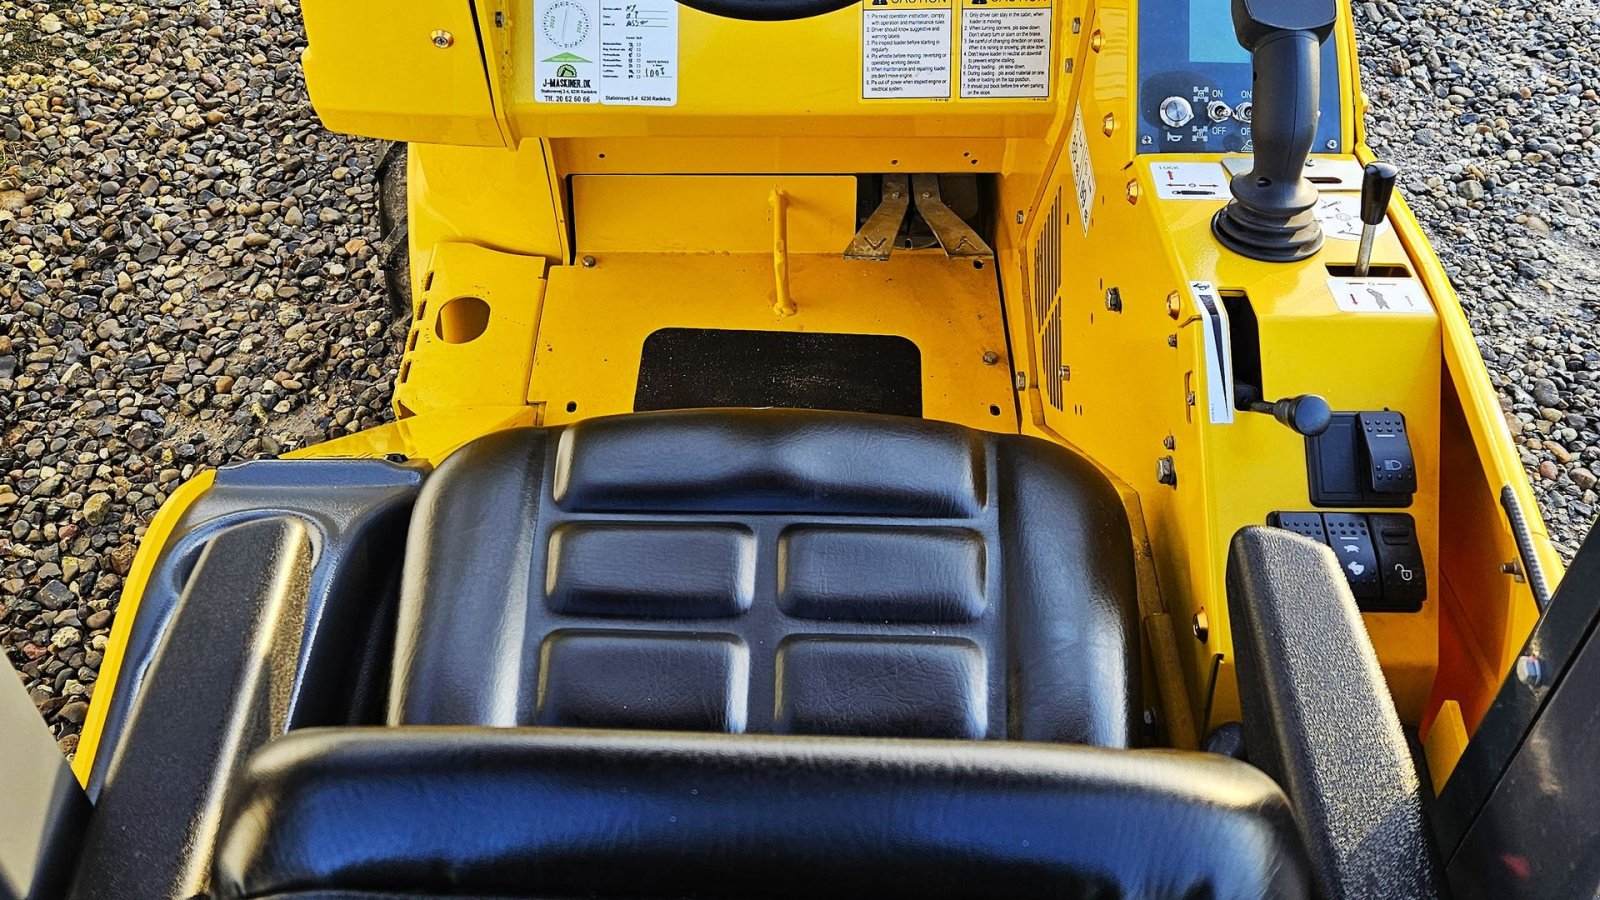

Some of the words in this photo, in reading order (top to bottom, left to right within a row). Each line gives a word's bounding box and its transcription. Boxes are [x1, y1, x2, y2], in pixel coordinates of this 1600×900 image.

[543, 78, 591, 88] J-MASKINER.DK
[1212, 89, 1223, 98] ON
[1241, 90, 1252, 98] ON
[1212, 127, 1226, 135] OFF
[1241, 127, 1251, 135] OF
